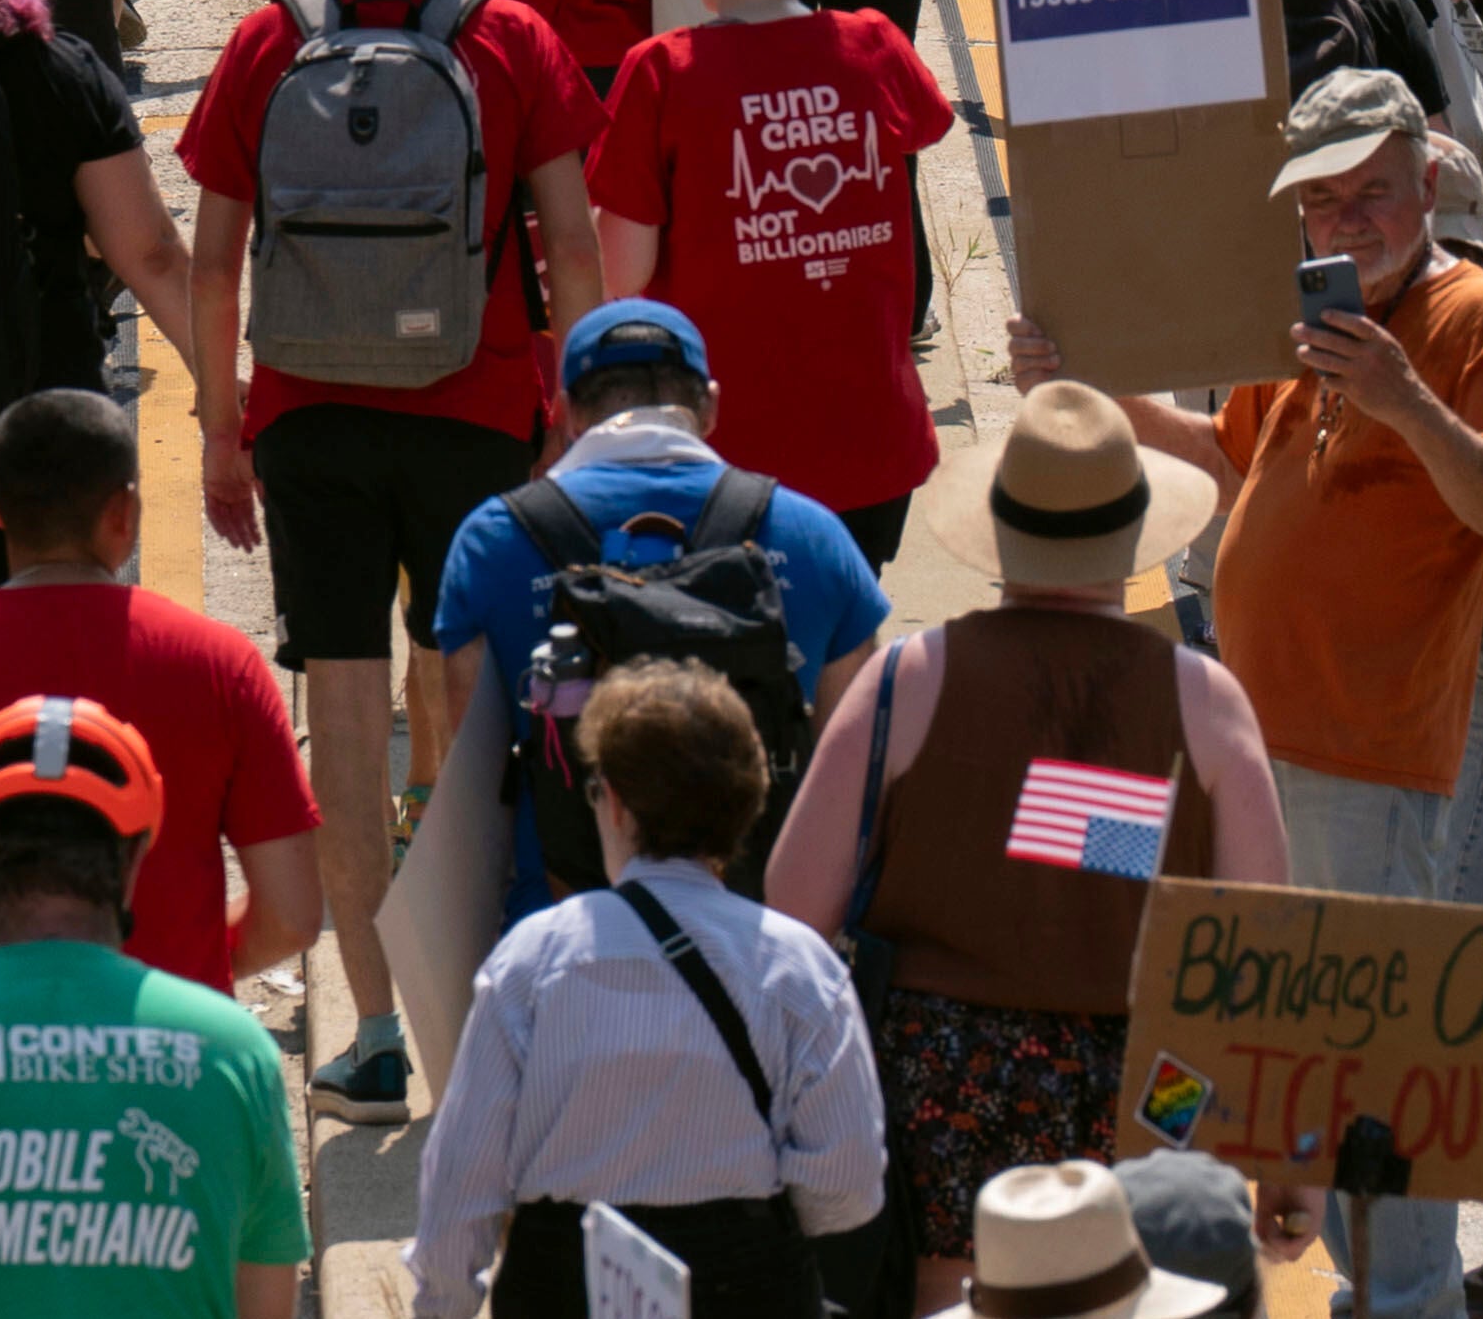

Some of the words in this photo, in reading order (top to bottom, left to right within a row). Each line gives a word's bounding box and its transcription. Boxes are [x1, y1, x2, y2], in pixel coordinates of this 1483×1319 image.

[741, 85, 840, 124] FUND
[762, 112, 858, 152] CARE
[734, 210, 799, 241] NOT
[737, 221, 893, 264] BILLIONAIRES
[8, 1023, 201, 1063] CONTE'S
[11, 1057, 100, 1083] BIKE
[107, 1057, 202, 1090] SHOP
